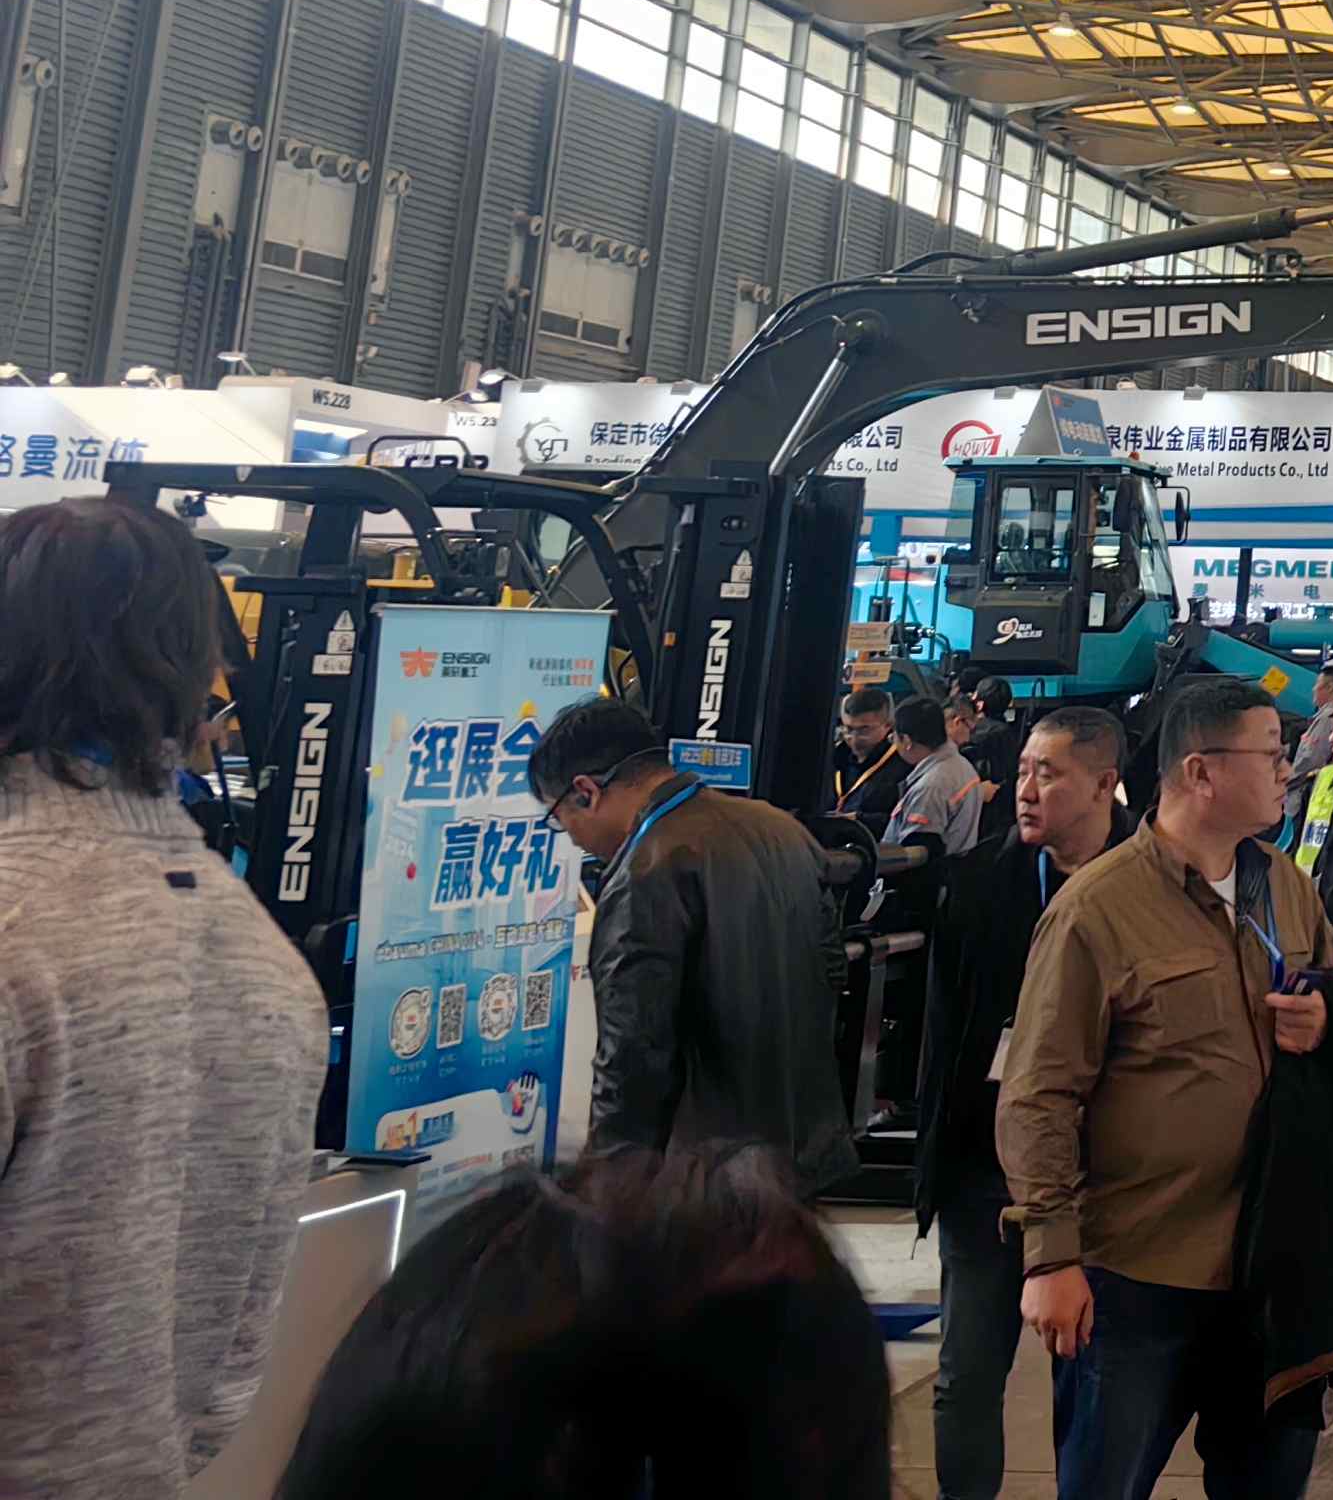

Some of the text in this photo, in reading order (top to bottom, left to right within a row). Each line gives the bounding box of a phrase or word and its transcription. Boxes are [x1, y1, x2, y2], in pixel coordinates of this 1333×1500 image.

[1025, 300, 1252, 345] ENSIGN
[846, 458, 873, 473] Co.,
[876, 457, 899, 472] Ltd
[1176, 462, 1215, 477] Metal
[1218, 462, 1276, 477] Products
[1279, 462, 1304, 479] Co.,
[1308, 462, 1329, 477] Ltd
[440, 652, 491, 665] ENSIGN
[696, 619, 733, 742] NSIGN
[279, 702, 333, 902] ENSIGN
[434, 822, 563, 904] 赢好礼
